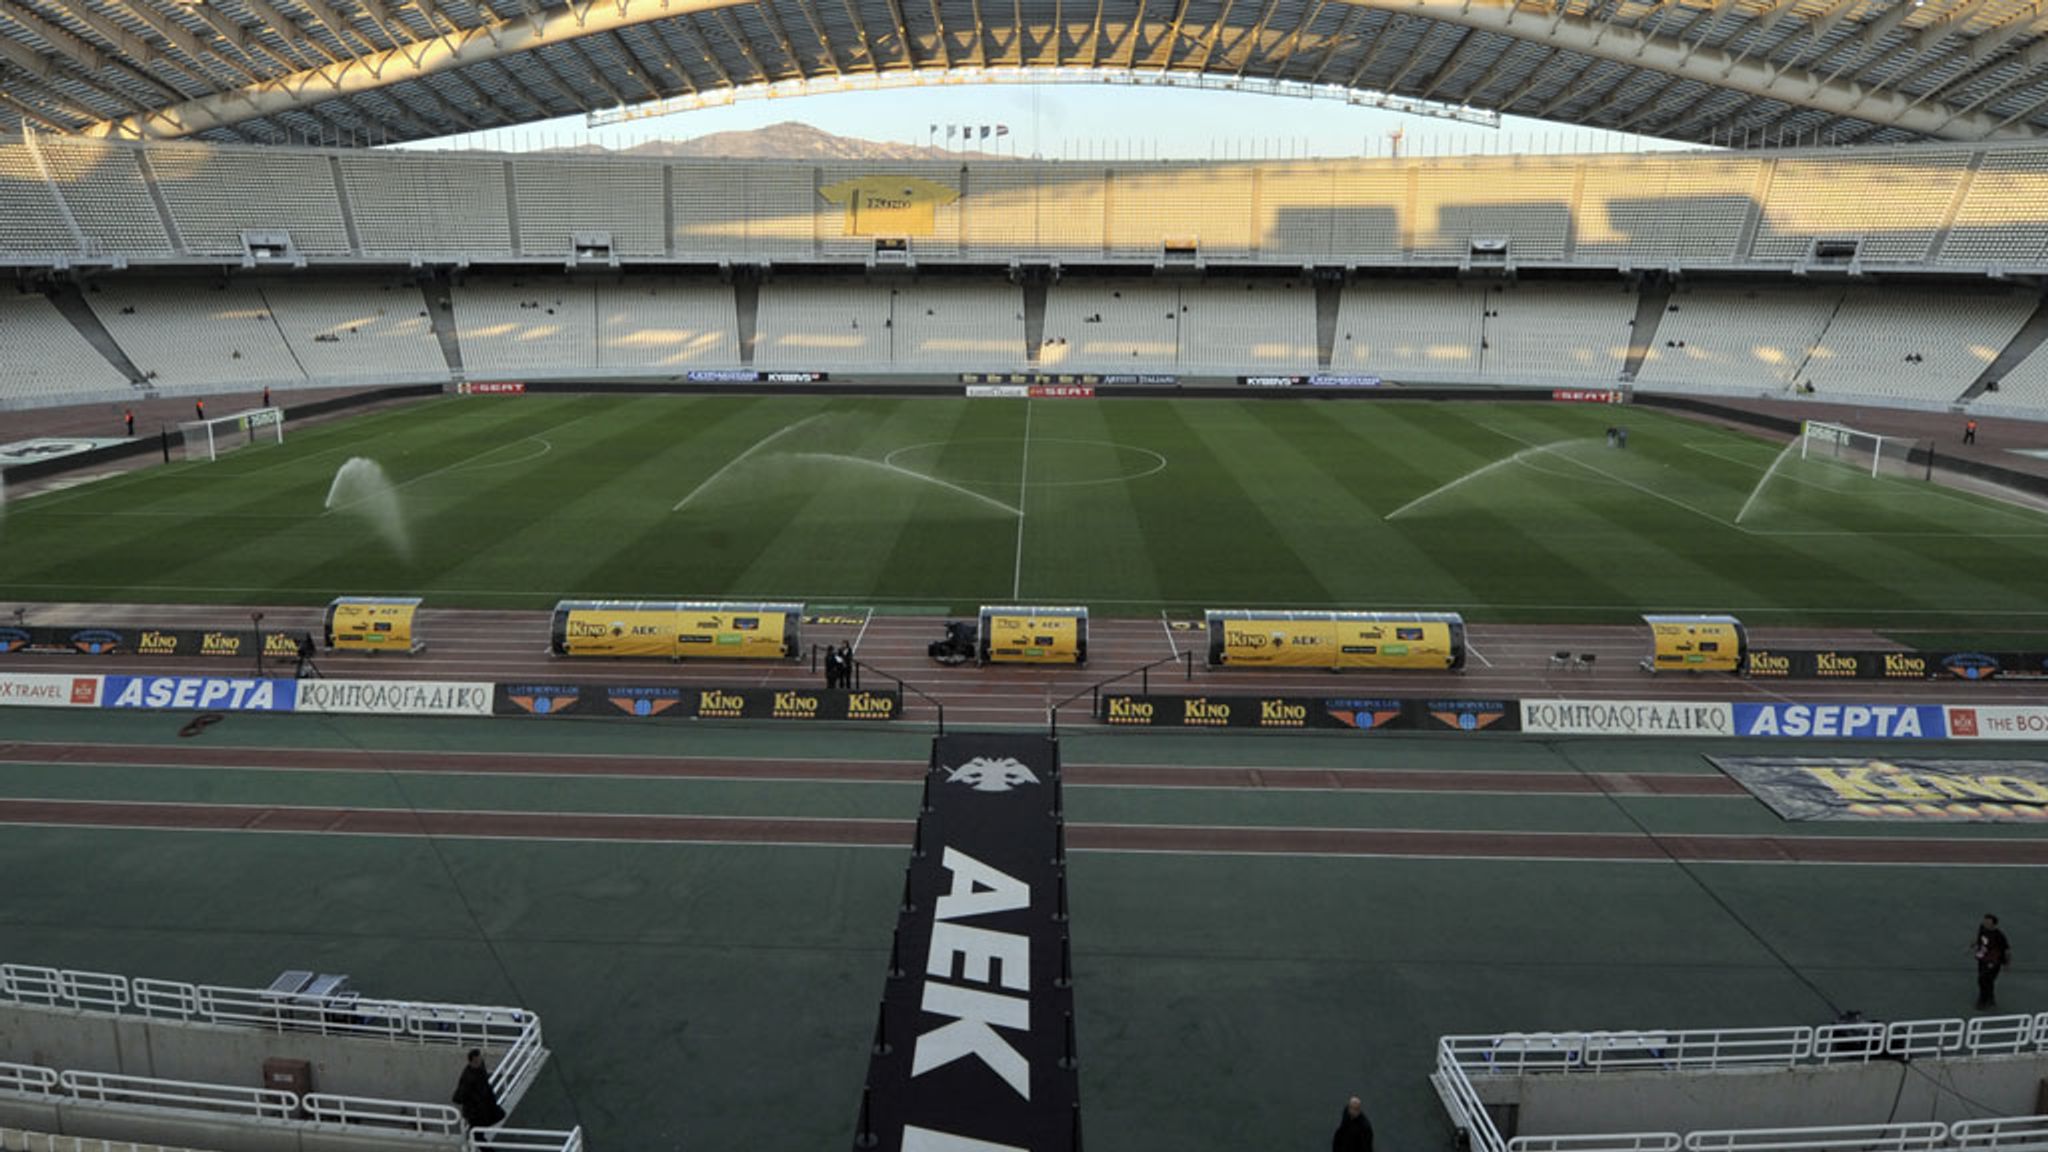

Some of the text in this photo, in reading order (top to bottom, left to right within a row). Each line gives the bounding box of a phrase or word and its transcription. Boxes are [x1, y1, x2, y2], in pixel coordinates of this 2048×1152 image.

[1045, 387, 1093, 396] SEAT
[16, 683, 62, 698] TRAVEL
[115, 678, 274, 709] ASEPTA
[1750, 705, 1923, 737] ASEPTA
[1987, 717, 2014, 731] THE
[911, 845, 1031, 1101] AEK
